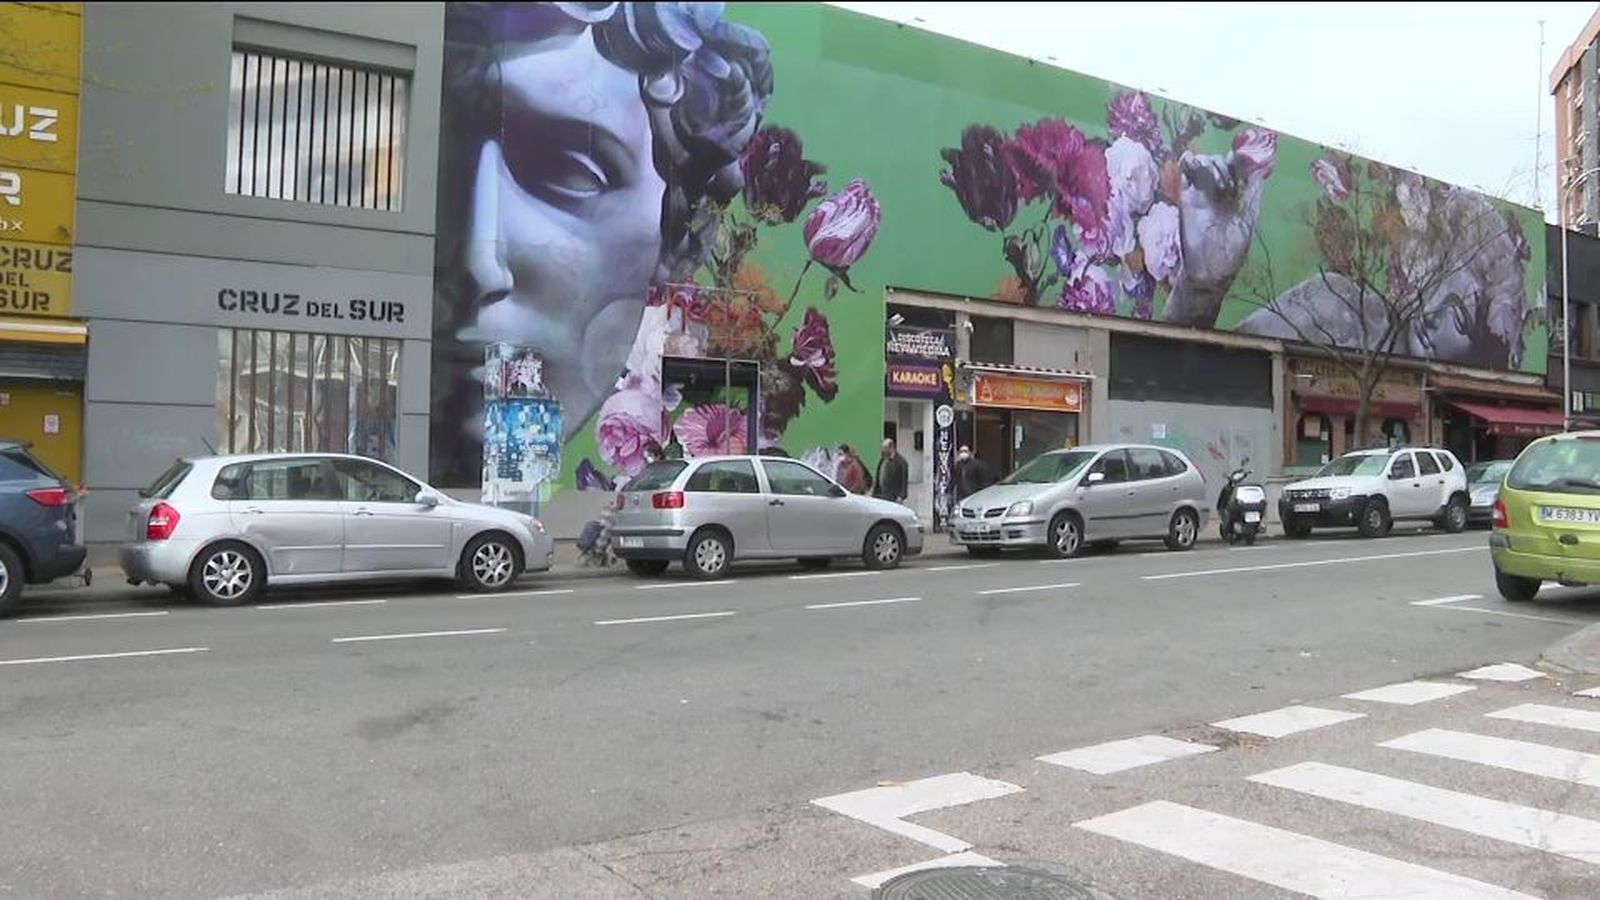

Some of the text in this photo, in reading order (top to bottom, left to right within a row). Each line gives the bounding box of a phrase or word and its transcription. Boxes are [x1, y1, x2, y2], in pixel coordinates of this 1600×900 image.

[218, 288, 404, 322] CRUZ DEL SUR
[892, 371, 938, 385] KARAOKE
